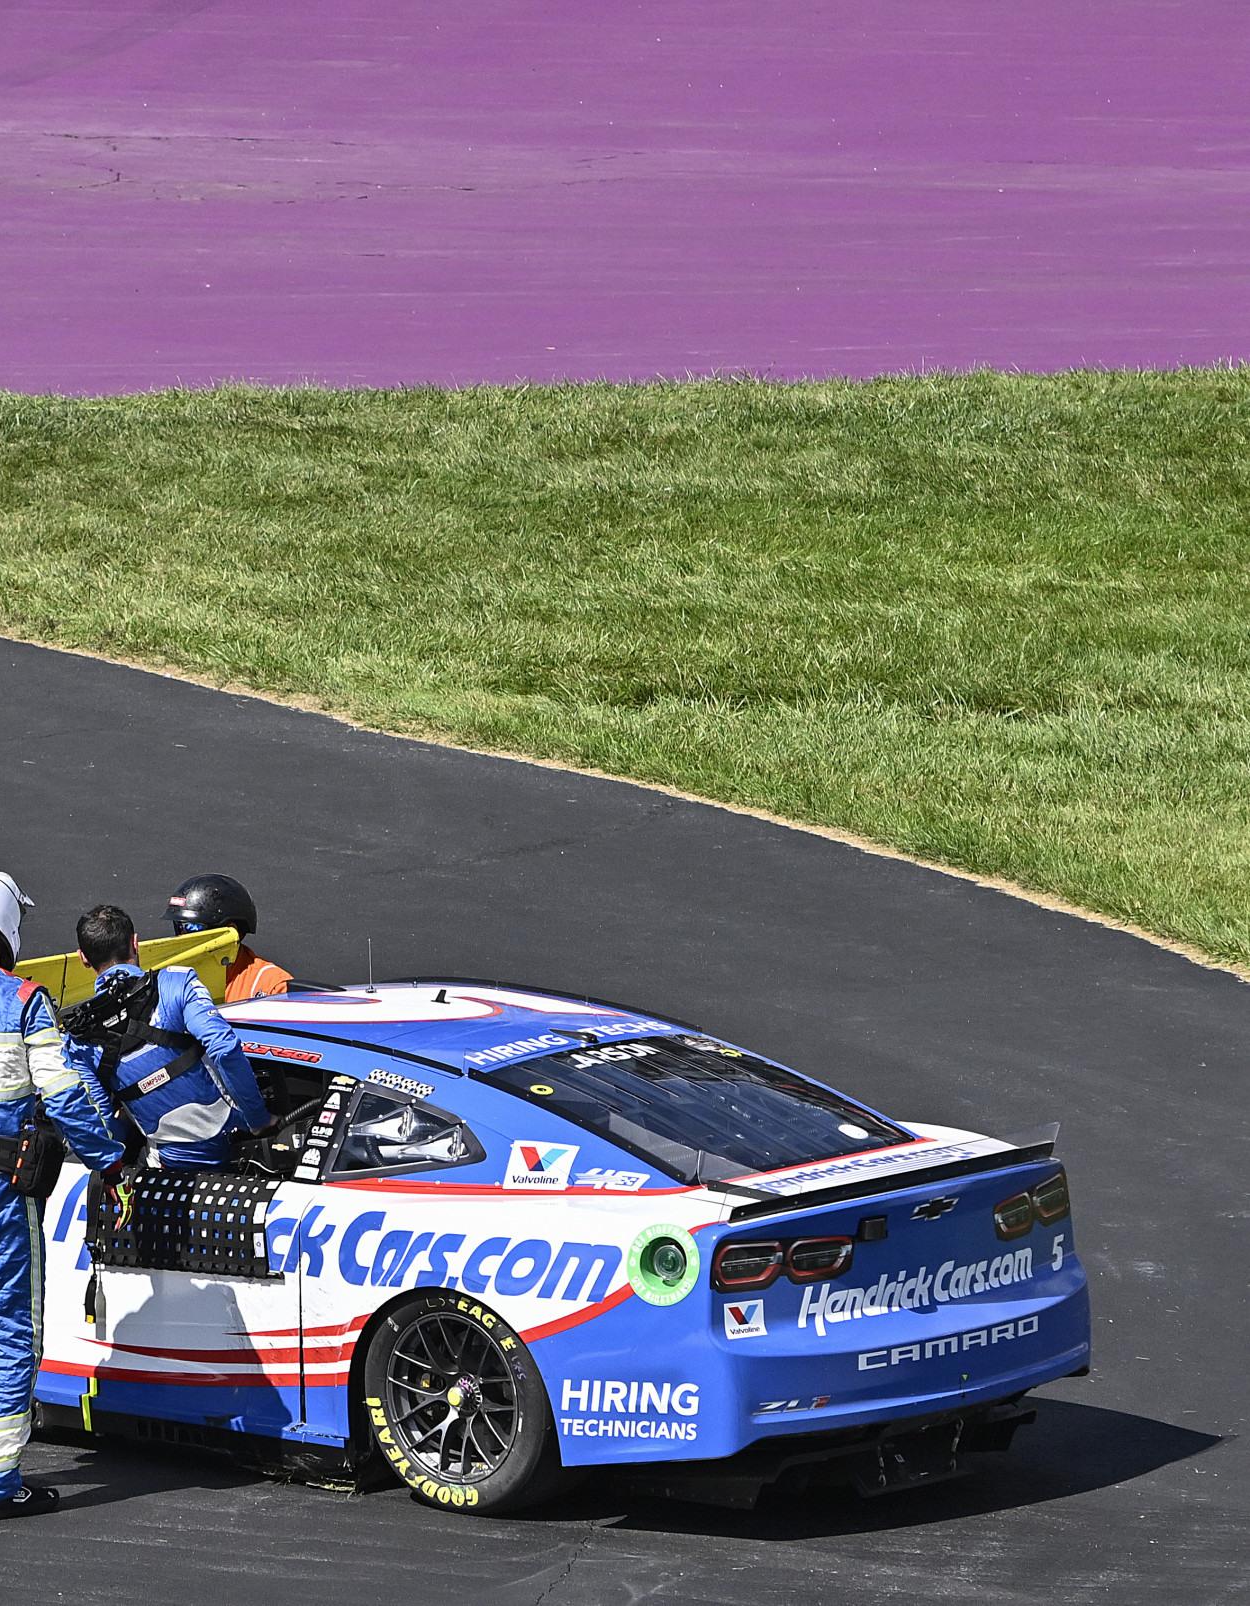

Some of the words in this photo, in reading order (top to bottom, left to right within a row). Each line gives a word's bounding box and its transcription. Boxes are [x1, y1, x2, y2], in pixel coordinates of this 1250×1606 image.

[464, 1034, 570, 1066] HIRING
[584, 1021, 672, 1038] TECHS
[142, 1072, 166, 1090] SIMPSON
[512, 1175, 559, 1185] Valvoline
[1051, 1233, 1065, 1272] 5
[729, 1326, 761, 1336] Valvoline
[858, 1316, 1039, 1371] CAMARO
[561, 1379, 700, 1416] HIRING
[753, 1395, 832, 1416] ZL1
[560, 1418, 698, 1441] TECHNICIANS
[371, 1412, 480, 1507] GOODYEAR
